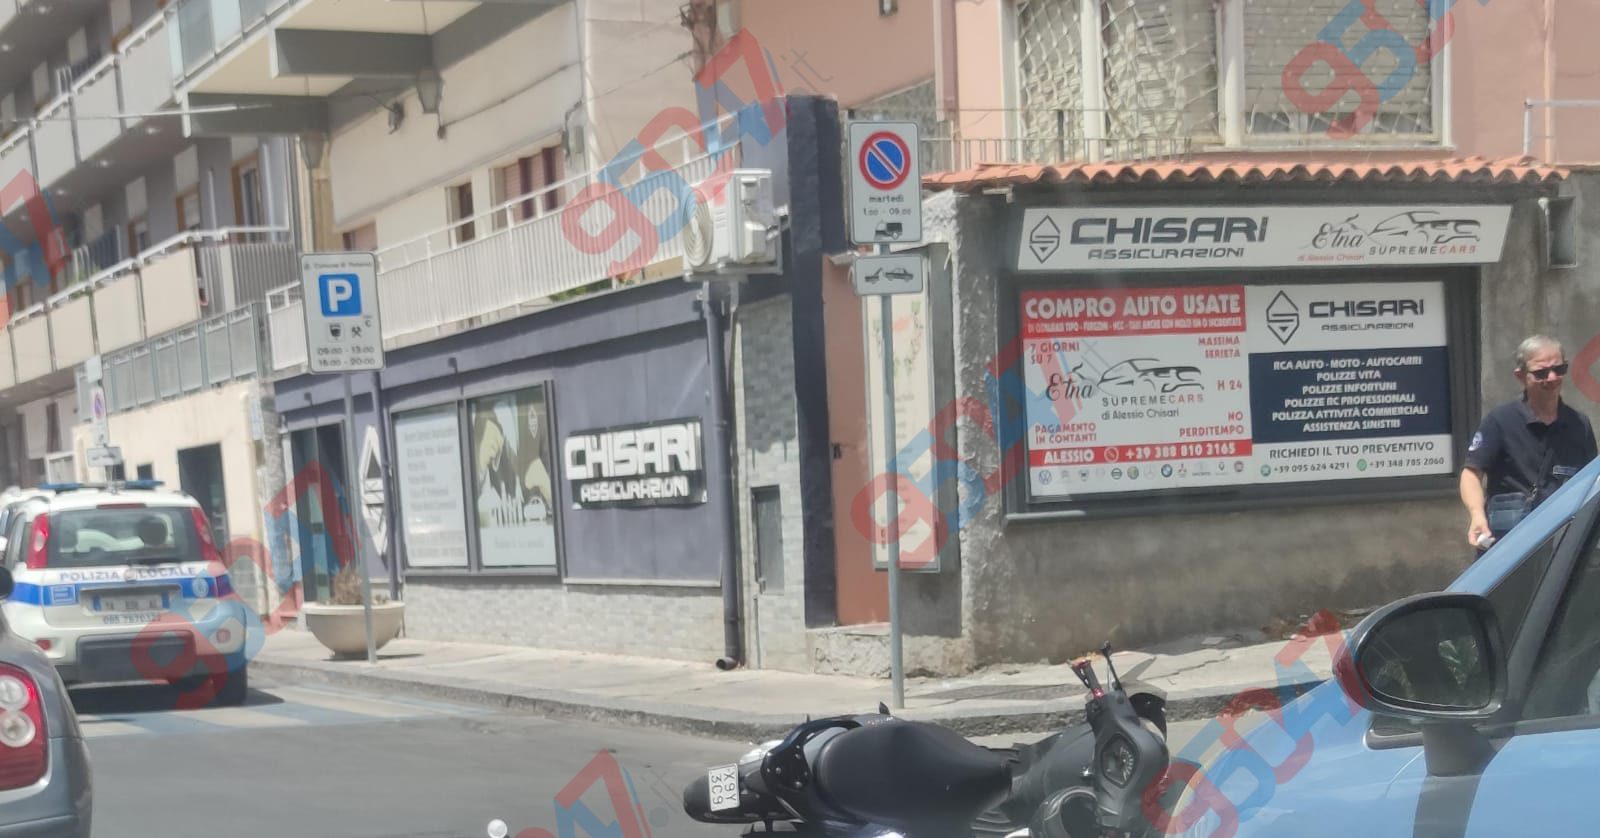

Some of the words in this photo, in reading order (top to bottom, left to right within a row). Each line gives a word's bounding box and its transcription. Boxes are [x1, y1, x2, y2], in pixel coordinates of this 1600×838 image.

[1070, 216, 1269, 245] CHISARI
[1311, 222, 1364, 249] Etna
[1088, 247, 1244, 260] ASSICURAZIONI
[1369, 245, 1477, 255] SUPREMECARS
[328, 279, 353, 312] P
[1025, 297, 1116, 319] COMPRO
[1122, 295, 1177, 317] AUTO
[1183, 294, 1241, 314] USATE
[1309, 299, 1424, 318] CHISARI
[1321, 322, 1414, 331] ASSICURAZIONI
[1031, 343, 1036, 352] 7
[1040, 342, 1079, 352] GIORNI
[1198, 336, 1240, 346] MASSIMA
[1031, 354, 1042, 364] SU
[1273, 360, 1293, 370] RCA
[1296, 359, 1324, 370] AUTO
[1330, 358, 1359, 368] MOTO
[1366, 356, 1422, 367] AUTOCARRI
[1317, 371, 1356, 381] POLIZZE
[1358, 370, 1381, 380] VITA
[1046, 373, 1093, 401] Etna
[1217, 380, 1225, 391] H
[1229, 379, 1242, 390] 24
[1302, 383, 1342, 394] POLIZZE
[1344, 382, 1397, 392] INFORTUNI
[1102, 394, 1204, 407] SUPREMECARS
[1285, 397, 1325, 408] POLIZZE
[1327, 397, 1338, 406] RC
[1341, 394, 1415, 405] PROFESSIONALI
[1101, 411, 1110, 420] di
[1112, 410, 1144, 420] Alessio
[1146, 408, 1179, 418] Chisari
[1228, 411, 1243, 421] NO
[1272, 410, 1314, 421] POLIZZA
[1315, 407, 1360, 419] ATTIVITÀ
[1361, 405, 1429, 417] COMMERCIALI
[1035, 423, 1096, 434] PAGAMENTO
[1179, 425, 1244, 437] PERDITEMPO
[1303, 421, 1360, 432] ASSISTENZA
[1362, 419, 1400, 429] SINISTRI
[1036, 434, 1046, 445] IN
[1049, 433, 1097, 444] CONTANTI
[565, 421, 702, 480] CHISARI
[1044, 449, 1095, 464] ALESSIO
[1270, 446, 1320, 459] RICHIEDI
[1323, 446, 1332, 456] IL
[1335, 444, 1359, 456] TUO
[1362, 442, 1434, 454] PREVENTIVO
[580, 475, 689, 503] ASSICURAZIONI
[59, 568, 120, 582] POLIZIA
[137, 565, 197, 579] LOCALE
[711, 775, 724, 805] 3C9
[723, 771, 737, 801] X9Y
